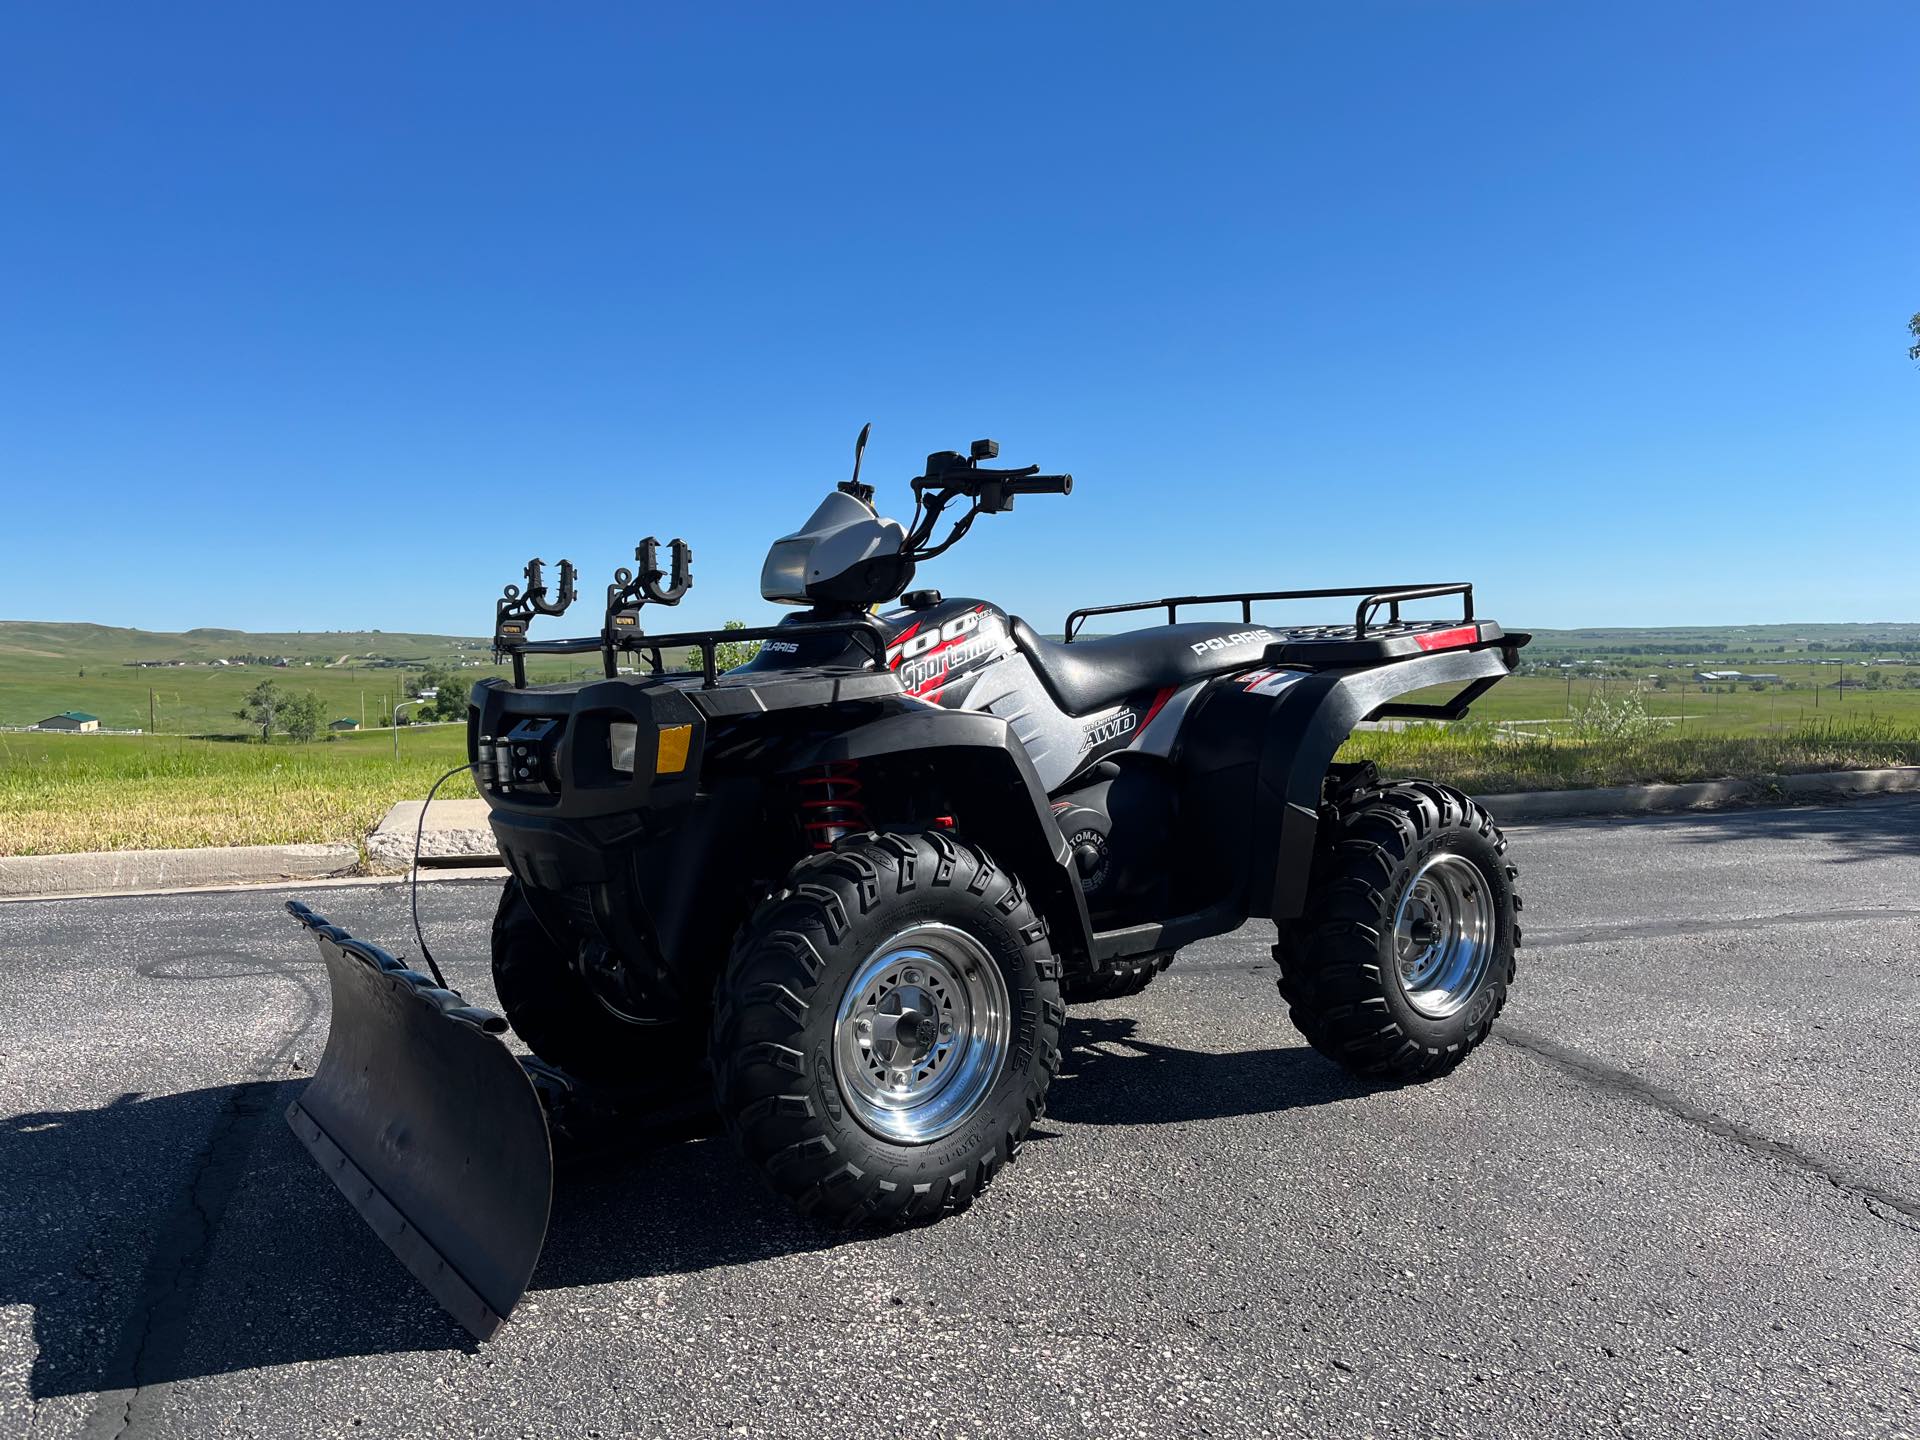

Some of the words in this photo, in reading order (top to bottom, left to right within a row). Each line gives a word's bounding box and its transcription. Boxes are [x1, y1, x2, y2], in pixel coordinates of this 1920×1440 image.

[1190, 629, 1274, 656] POLARIS
[1078, 712, 1137, 754] AWD
[1068, 831, 1109, 856] TOMATIC
